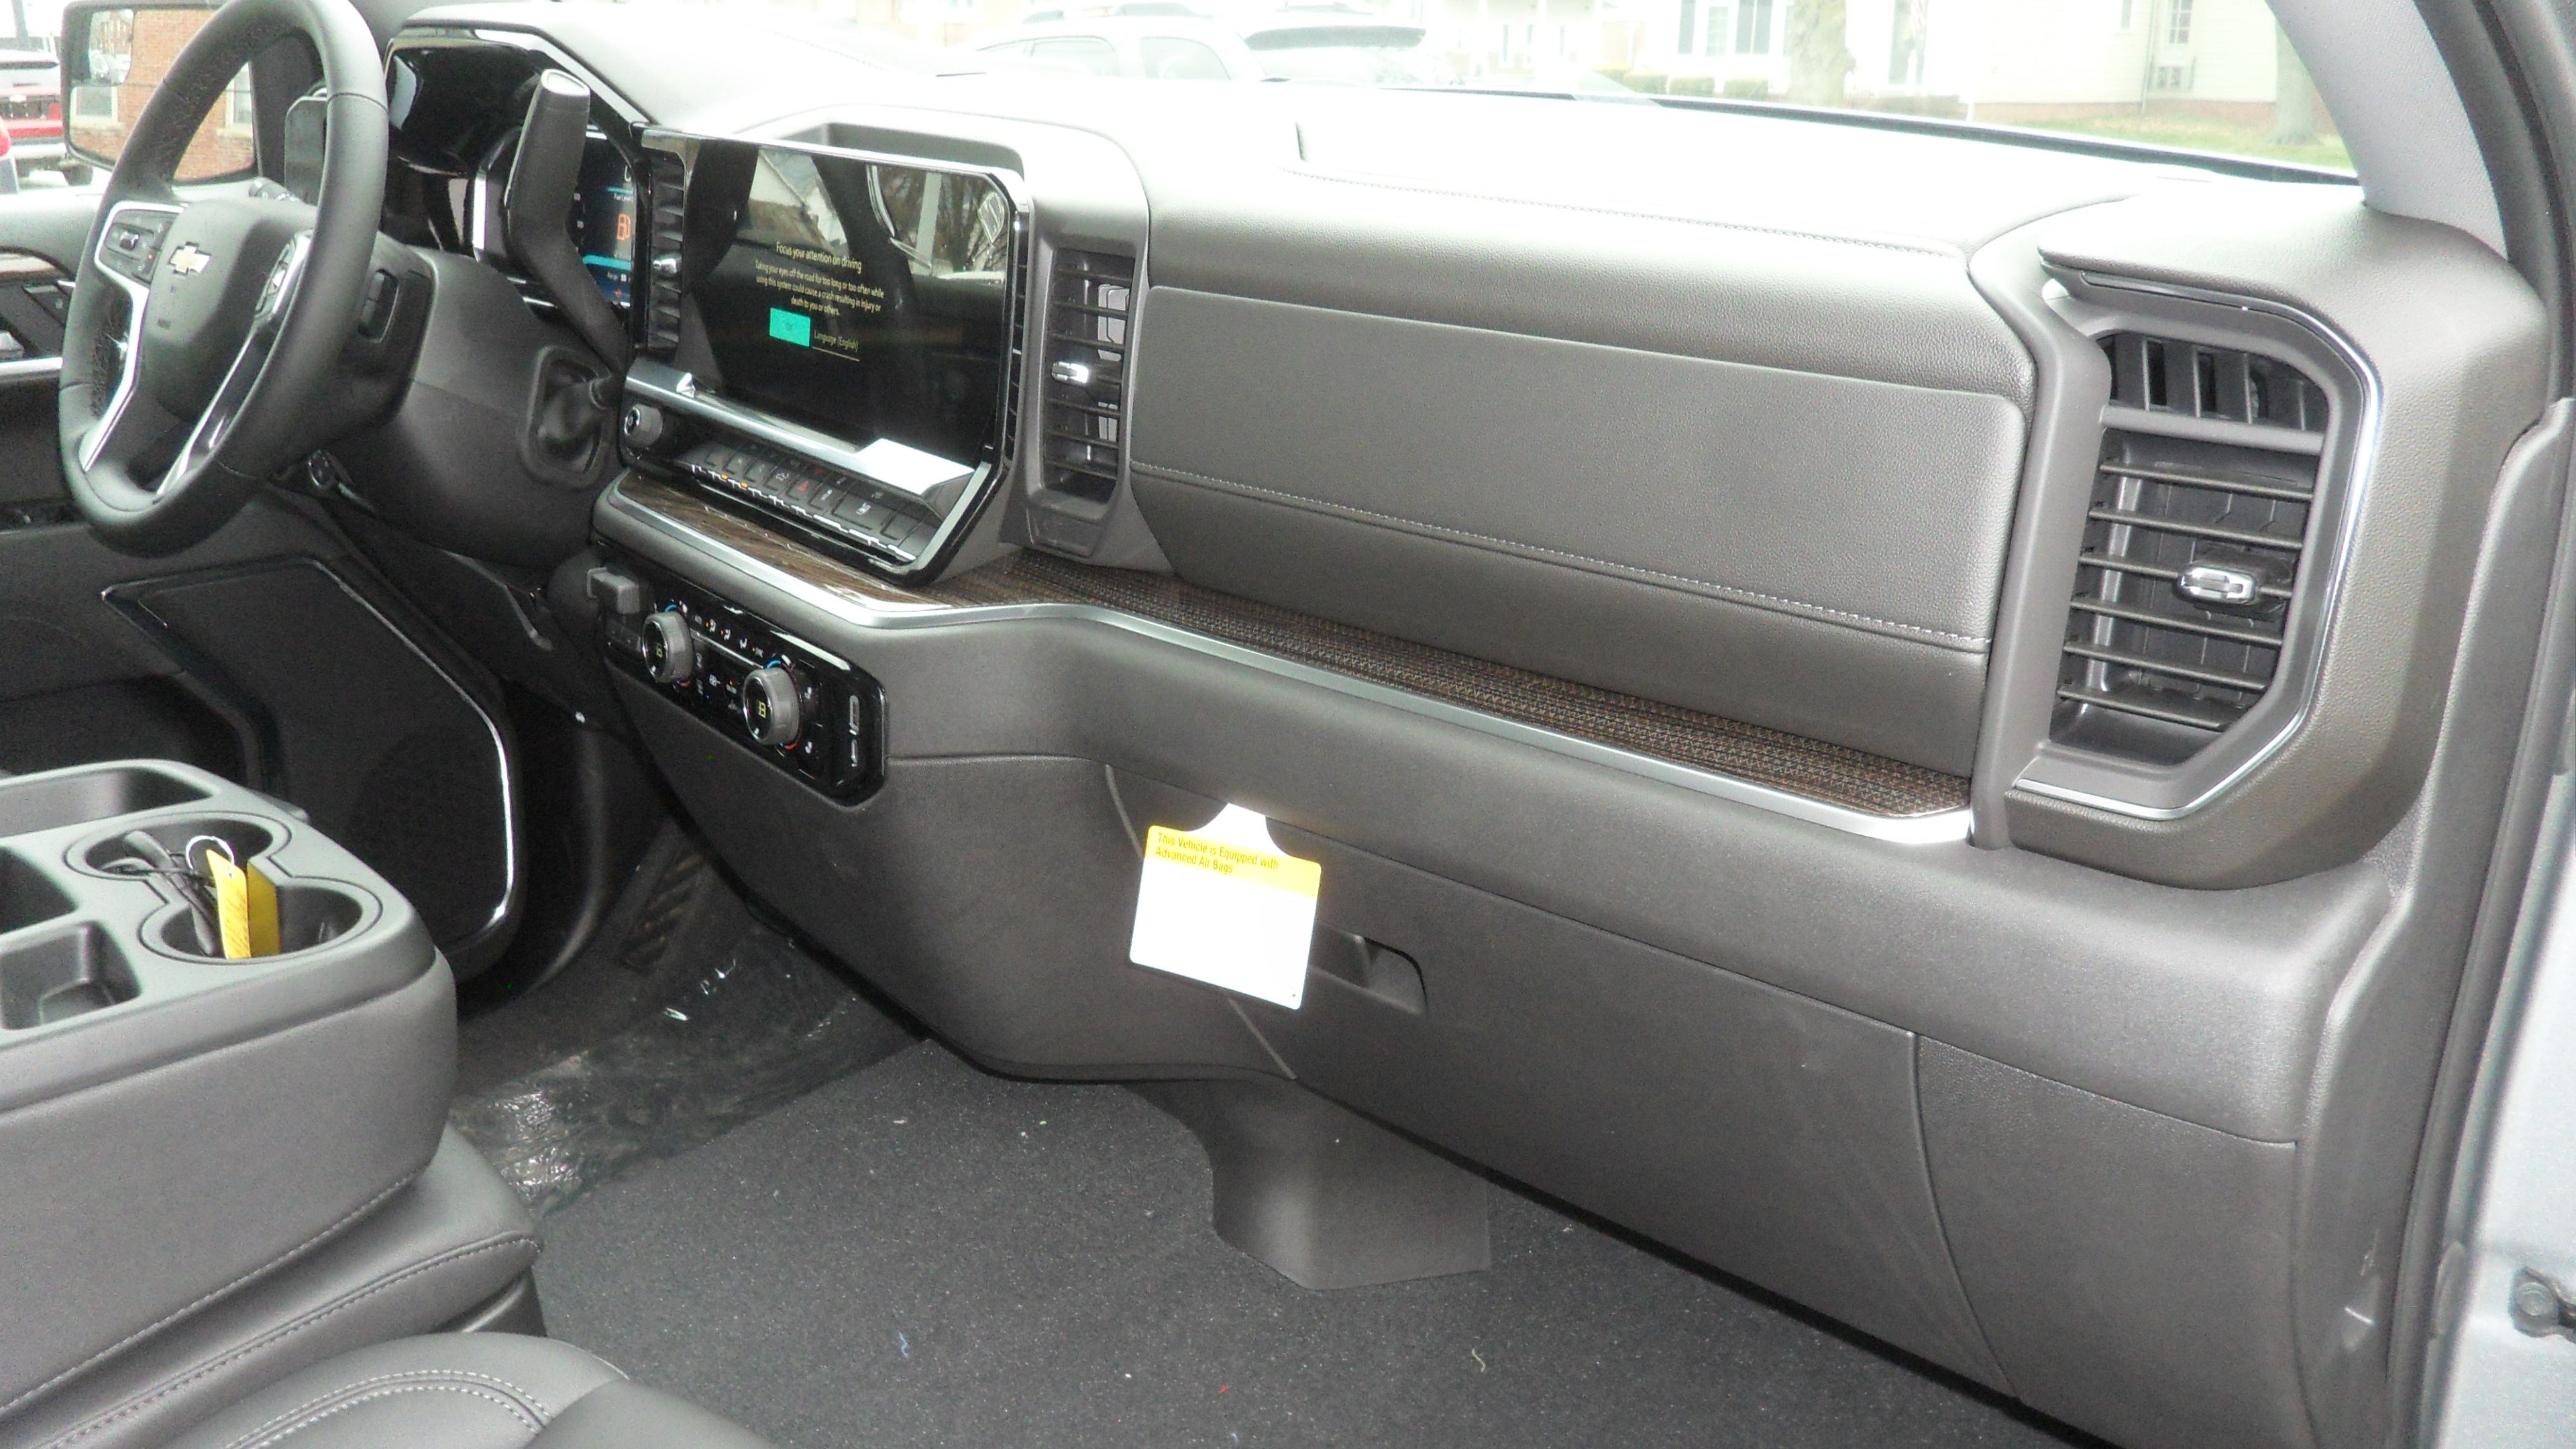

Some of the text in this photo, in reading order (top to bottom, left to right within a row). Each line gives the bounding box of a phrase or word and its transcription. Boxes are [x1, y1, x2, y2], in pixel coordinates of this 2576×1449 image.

[776, 241, 862, 274] Focus your attention on driving
[831, 278, 842, 290] long
[849, 282, 857, 291] too
[857, 283, 870, 294] often
[822, 290, 834, 300] crash
[861, 299, 875, 313] injury
[1155, 847, 1234, 874] Advanced Air Bags
[1158, 833, 1279, 870] This Vehicle is Equipped with
